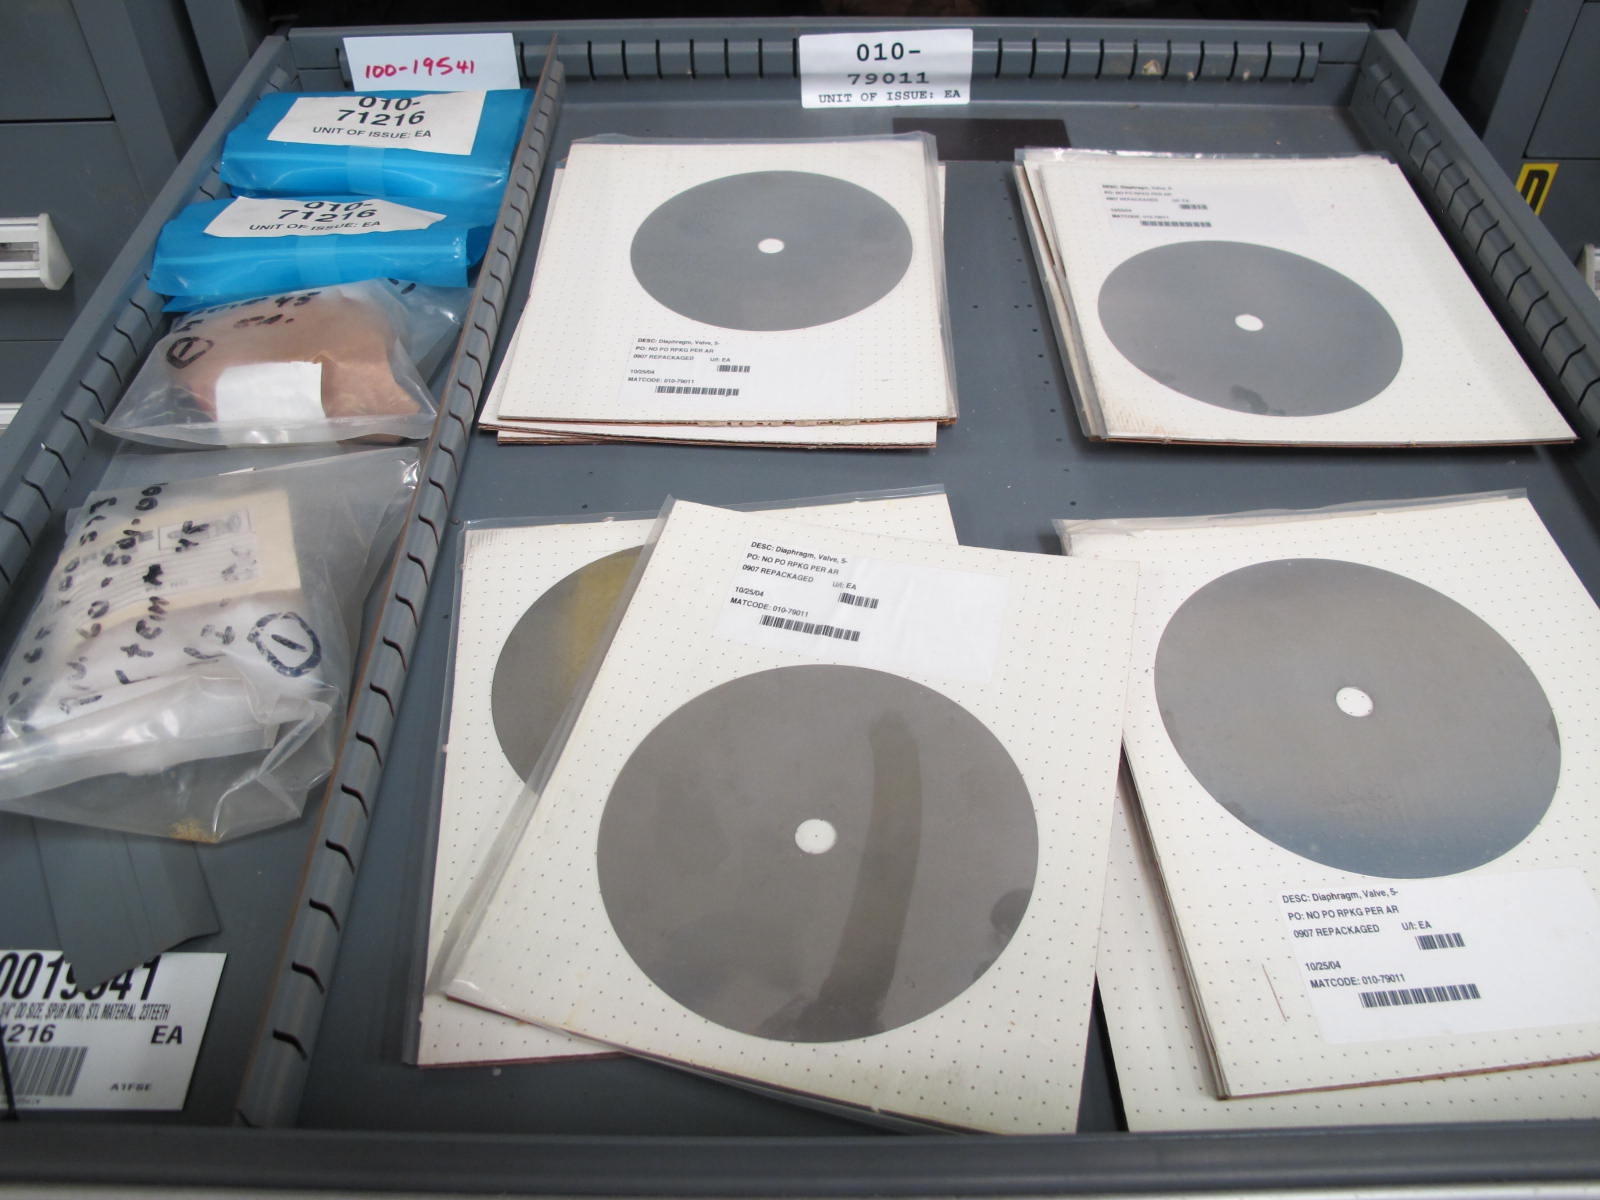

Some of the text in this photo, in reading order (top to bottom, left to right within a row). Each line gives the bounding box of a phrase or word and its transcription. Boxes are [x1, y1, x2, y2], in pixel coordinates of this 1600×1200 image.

[857, 42, 921, 62] 010-
[847, 72, 930, 85] 79011
[358, 96, 421, 111] 010-
[818, 89, 961, 103] UNIT OF ISSUE: EA
[336, 109, 426, 127] 71216
[312, 126, 431, 139] UNIT OF ISSUE: EA
[303, 201, 374, 212] 010-
[278, 209, 377, 223] 71216
[249, 223, 285, 231] UNIT
[310, 222, 358, 232] ISSUE:
[361, 220, 381, 228] EA
[751, 541, 775, 551] DESC:
[776, 546, 816, 560] Diaphragm,
[818, 553, 840, 564] Valve,
[746, 552, 840, 576] PO: NO PO RPKG PER AR
[742, 564, 759, 573] 0907
[760, 567, 814, 583] REPACKAGED
[845, 582, 857, 590] EA
[735, 586, 765, 597] 10/25/04
[730, 597, 809, 618] MATCODE: 010-79011
[1282, 894, 1310, 904] DESC:
[1312, 890, 1361, 903] Diaphragm,
[1362, 889, 1389, 899] Valve,
[1288, 904, 1400, 921] PO: NO PO RPKG PER AR
[1293, 928, 1314, 938] 0907
[1316, 924, 1380, 937] REPACKAGED
[1418, 920, 1432, 930] EA
[1305, 960, 1342, 972] 10/25/04
[1310, 973, 1406, 989] MATCODE: 010-79011
[150, 1025, 183, 1045] EA
